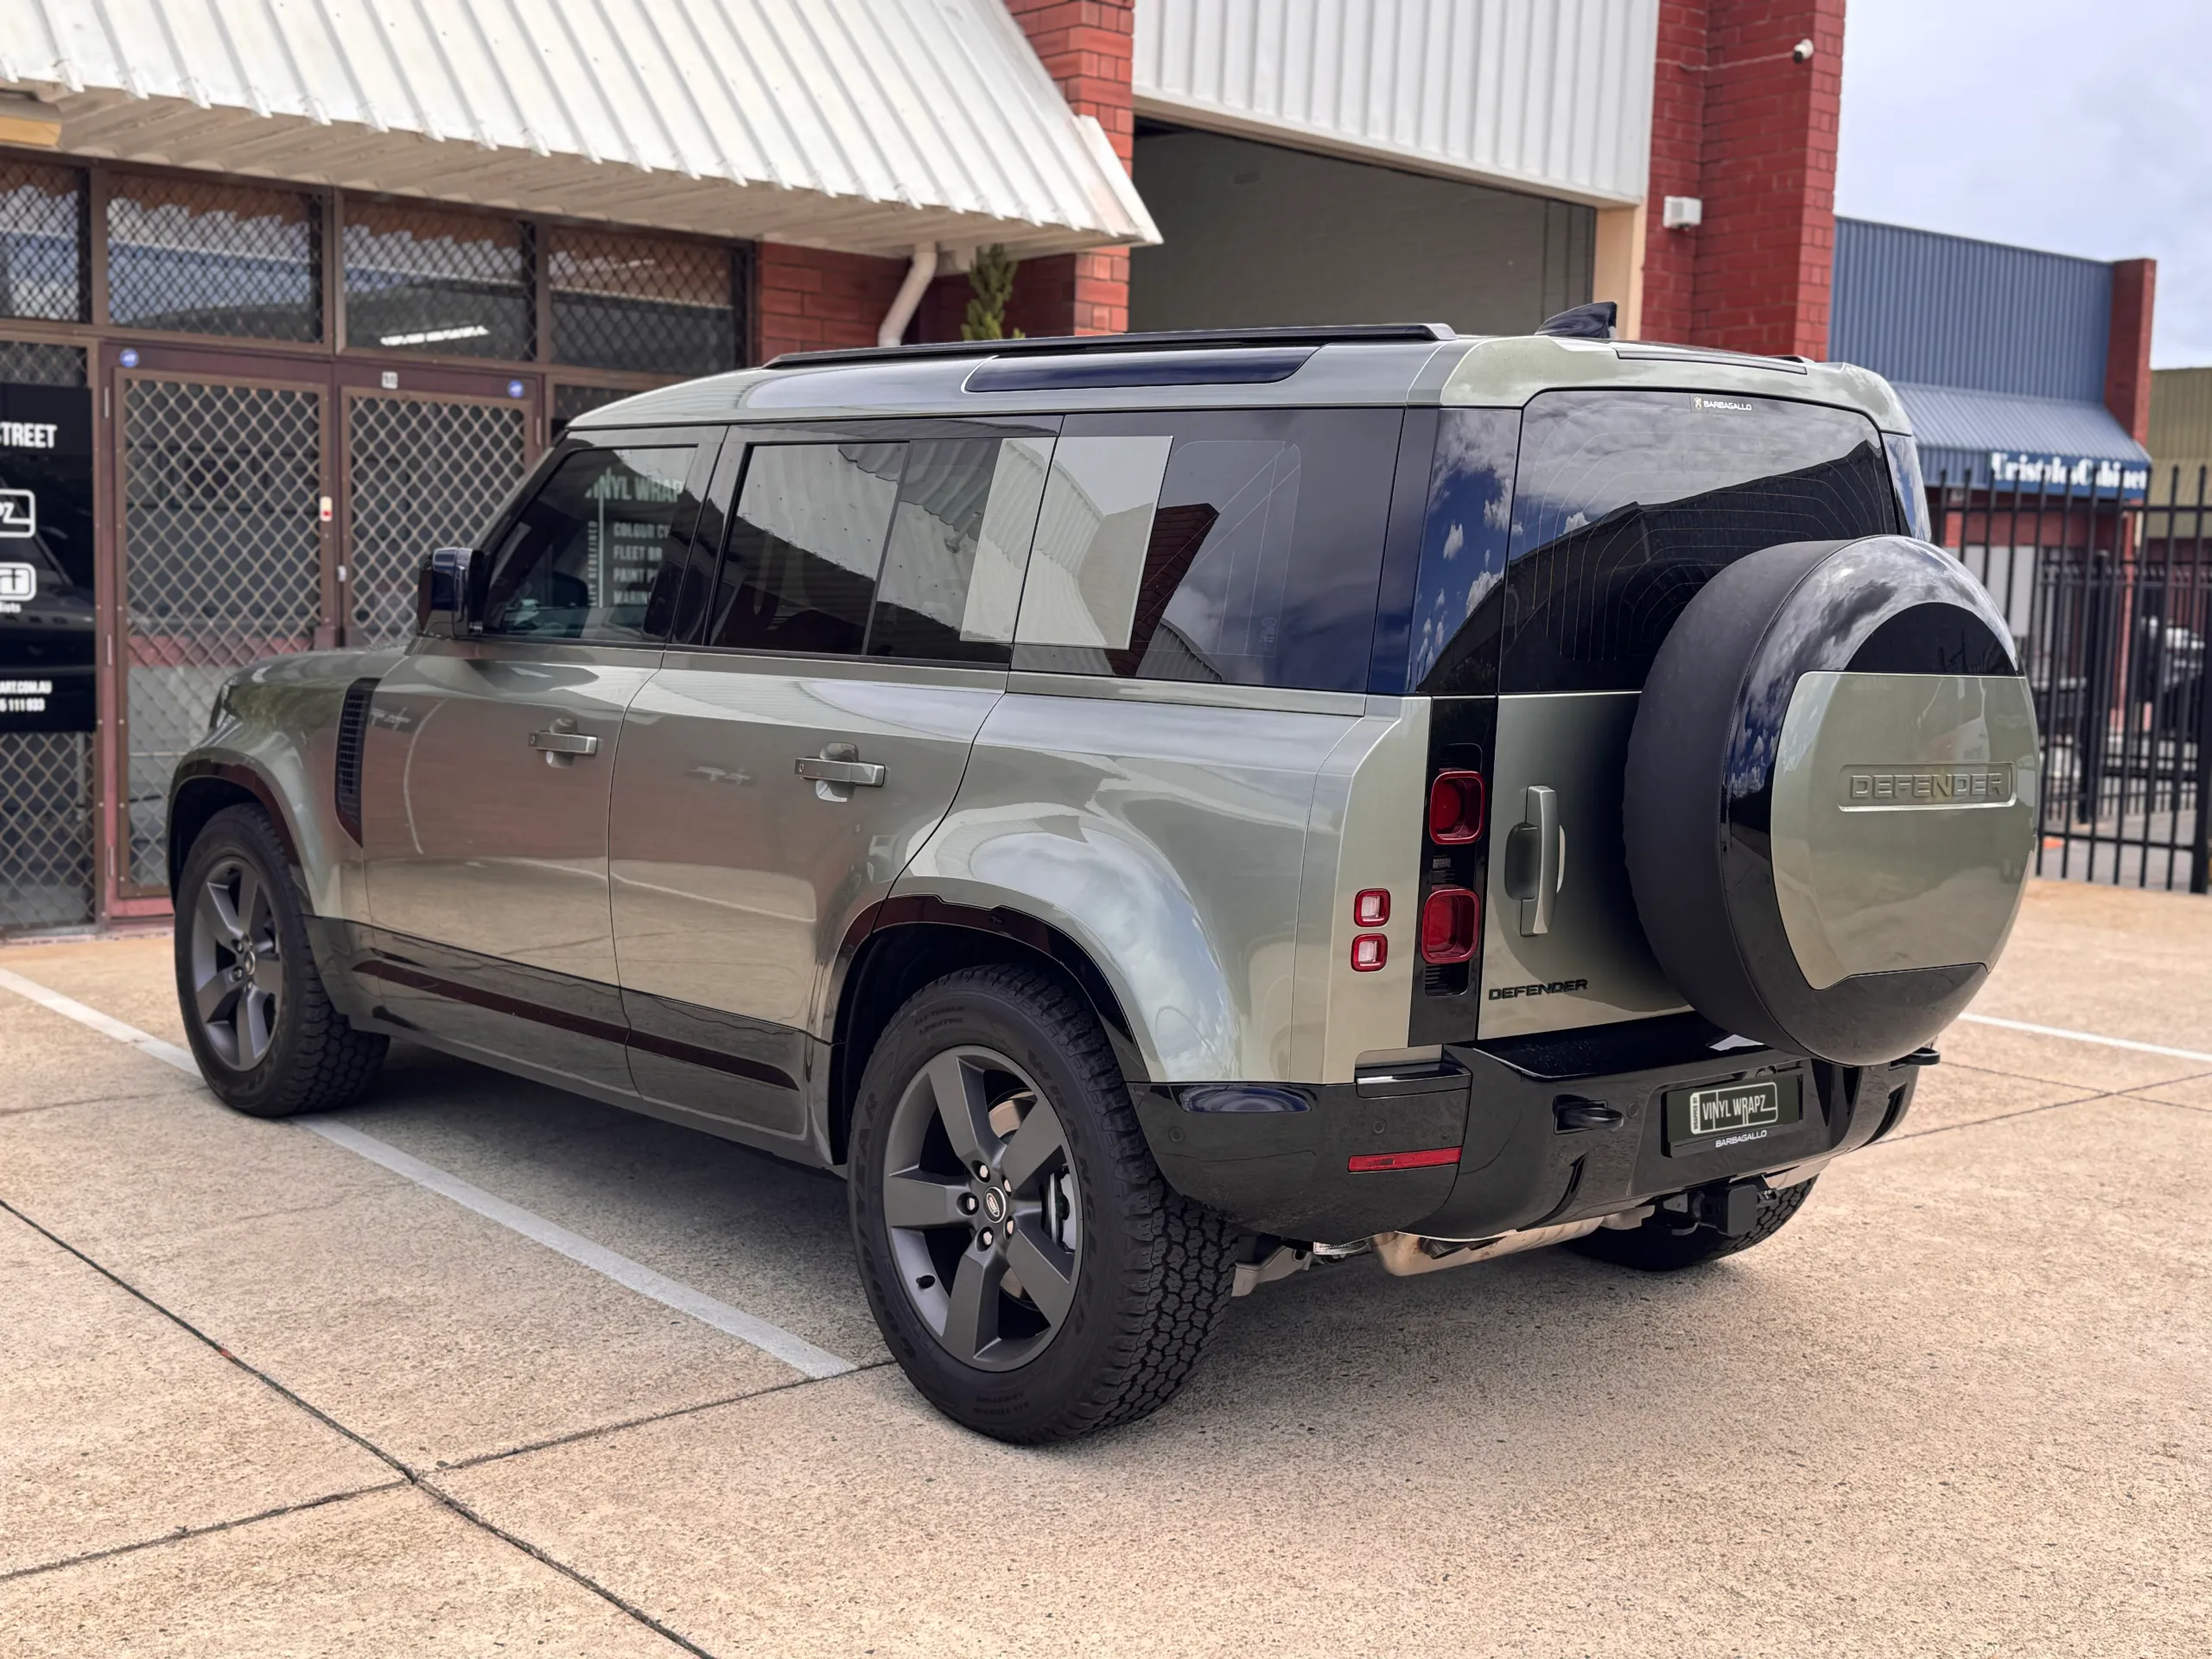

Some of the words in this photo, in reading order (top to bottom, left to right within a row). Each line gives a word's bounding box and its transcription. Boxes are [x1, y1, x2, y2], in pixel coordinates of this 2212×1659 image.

[1703, 400, 1752, 410] BARBAGALLO
[0, 422, 58, 448] TREET
[613, 544, 645, 561] FLEET
[613, 567, 645, 582] PAINT
[1849, 772, 2003, 799] DEFENDER
[1488, 978, 1588, 1001] DEFENDER
[1702, 1097, 1732, 1122] VINYL
[1732, 1094, 1768, 1118] WRAPZ
[1715, 1129, 1768, 1148] BARBAGALLO
